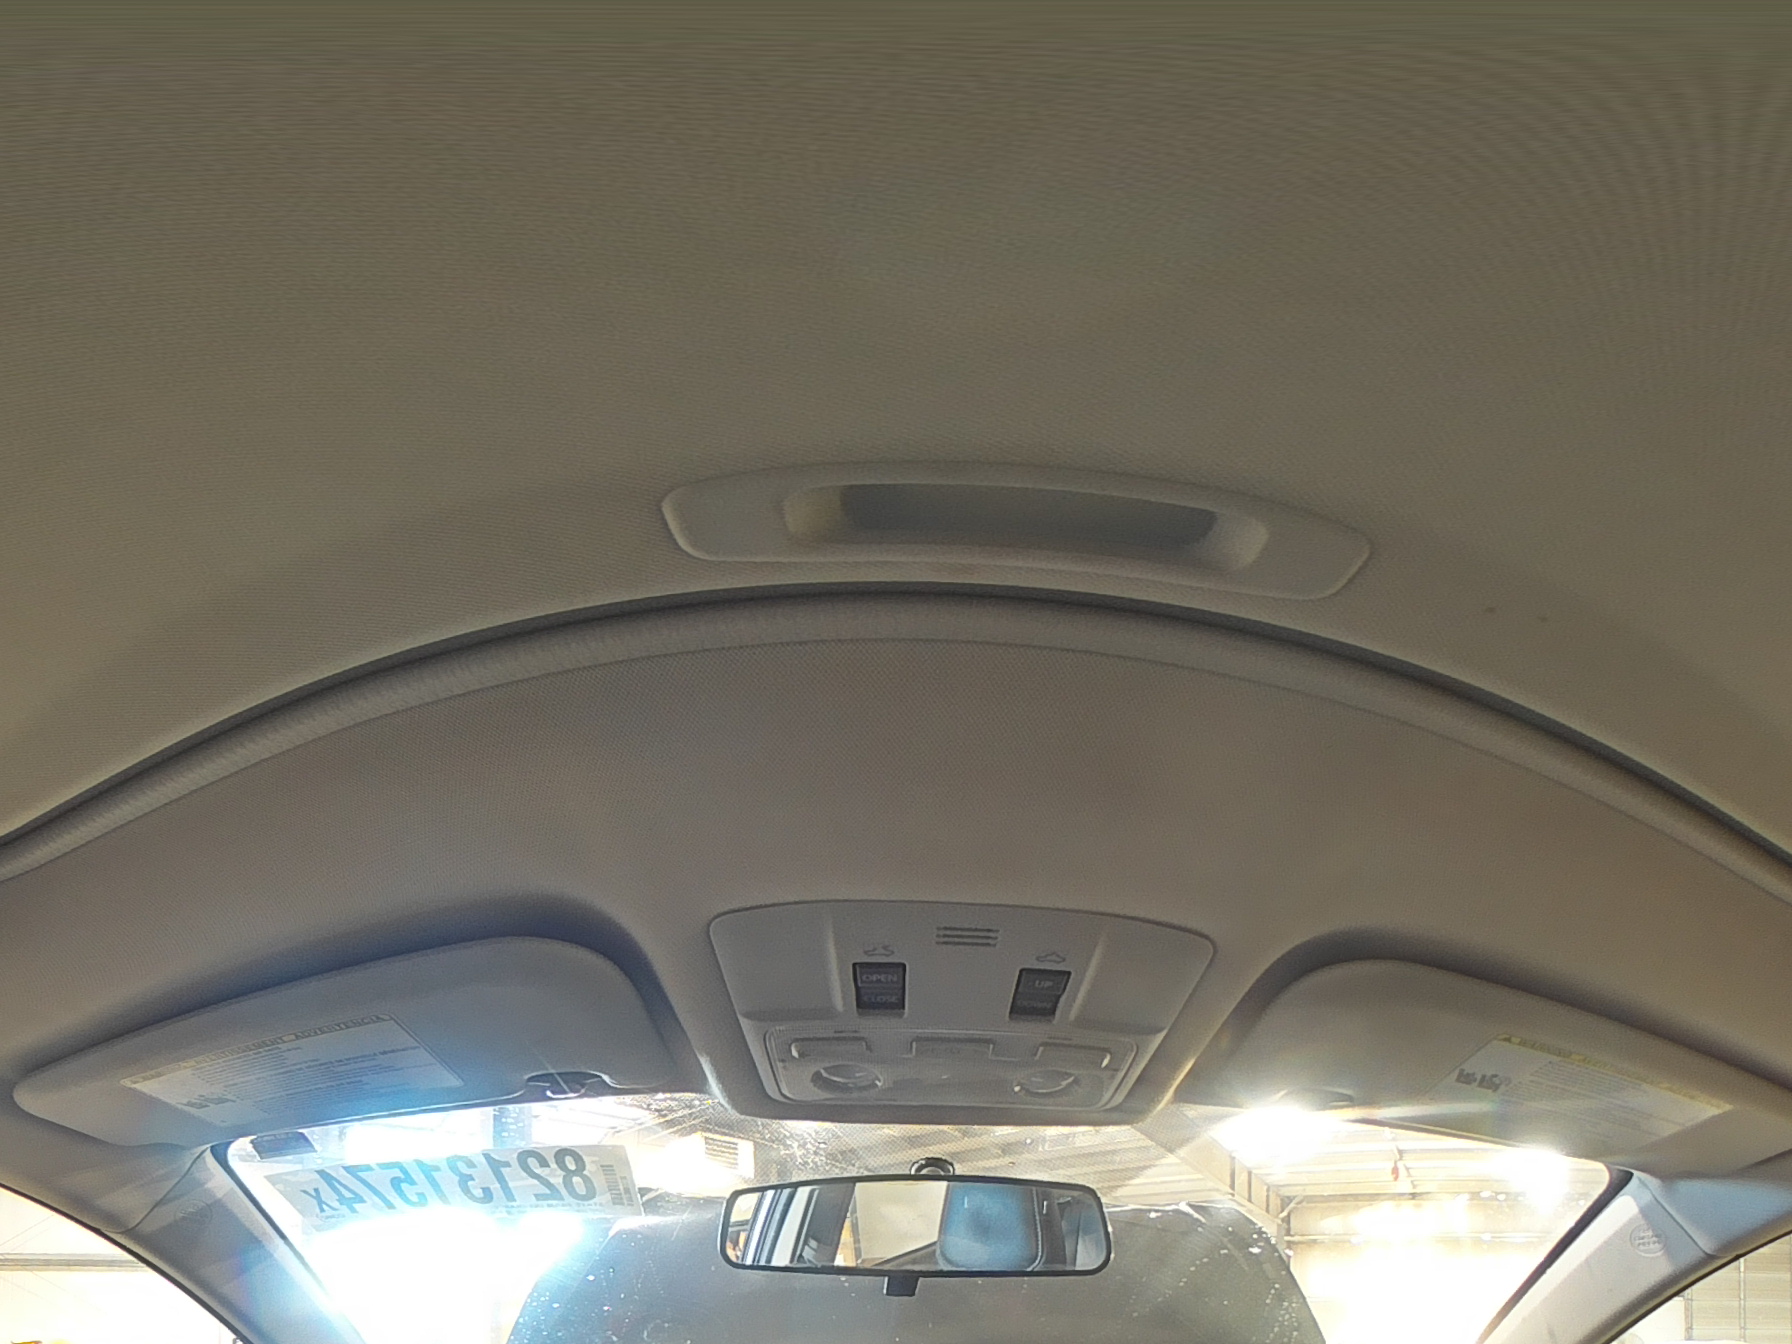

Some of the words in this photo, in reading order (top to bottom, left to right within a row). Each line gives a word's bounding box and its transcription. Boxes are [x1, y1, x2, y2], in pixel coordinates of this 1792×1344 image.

[861, 973, 898, 983] OPEN
[1034, 979, 1054, 989] UP
[863, 994, 899, 1004] CLOSE
